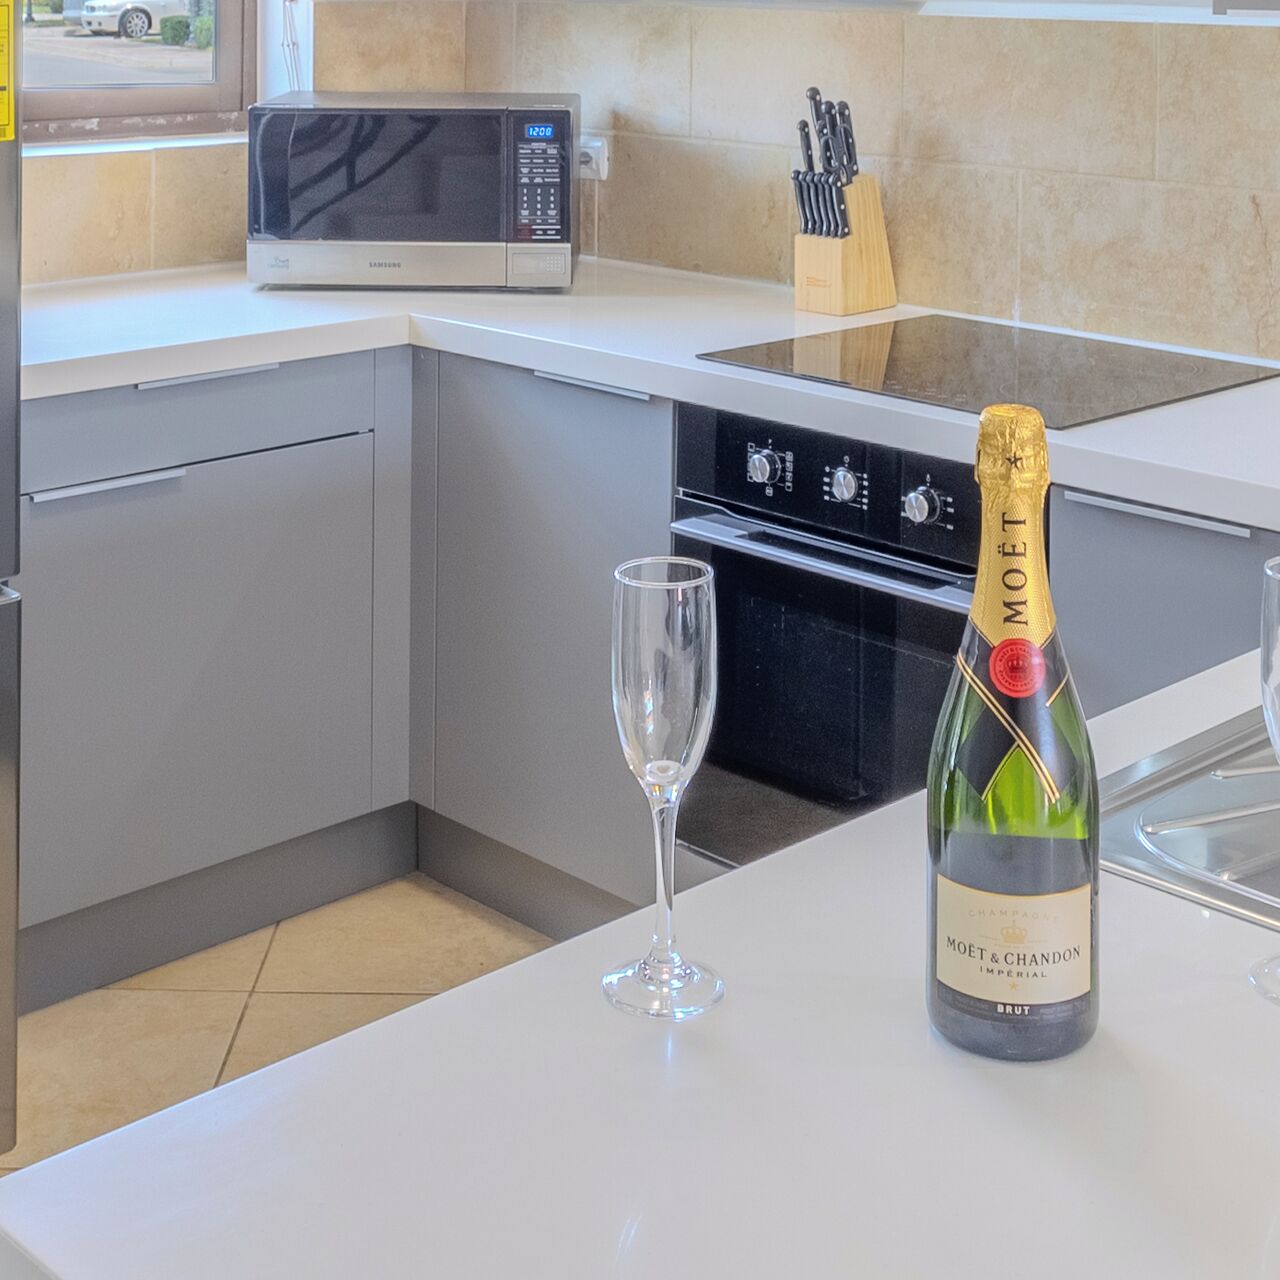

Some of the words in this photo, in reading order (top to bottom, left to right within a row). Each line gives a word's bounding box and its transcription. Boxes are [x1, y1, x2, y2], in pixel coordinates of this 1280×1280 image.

[998, 511, 1029, 626] MOËT
[990, 952, 1000, 965] &
[1004, 945, 1082, 967] CHANDON
[997, 1004, 1031, 1016] BRUT
